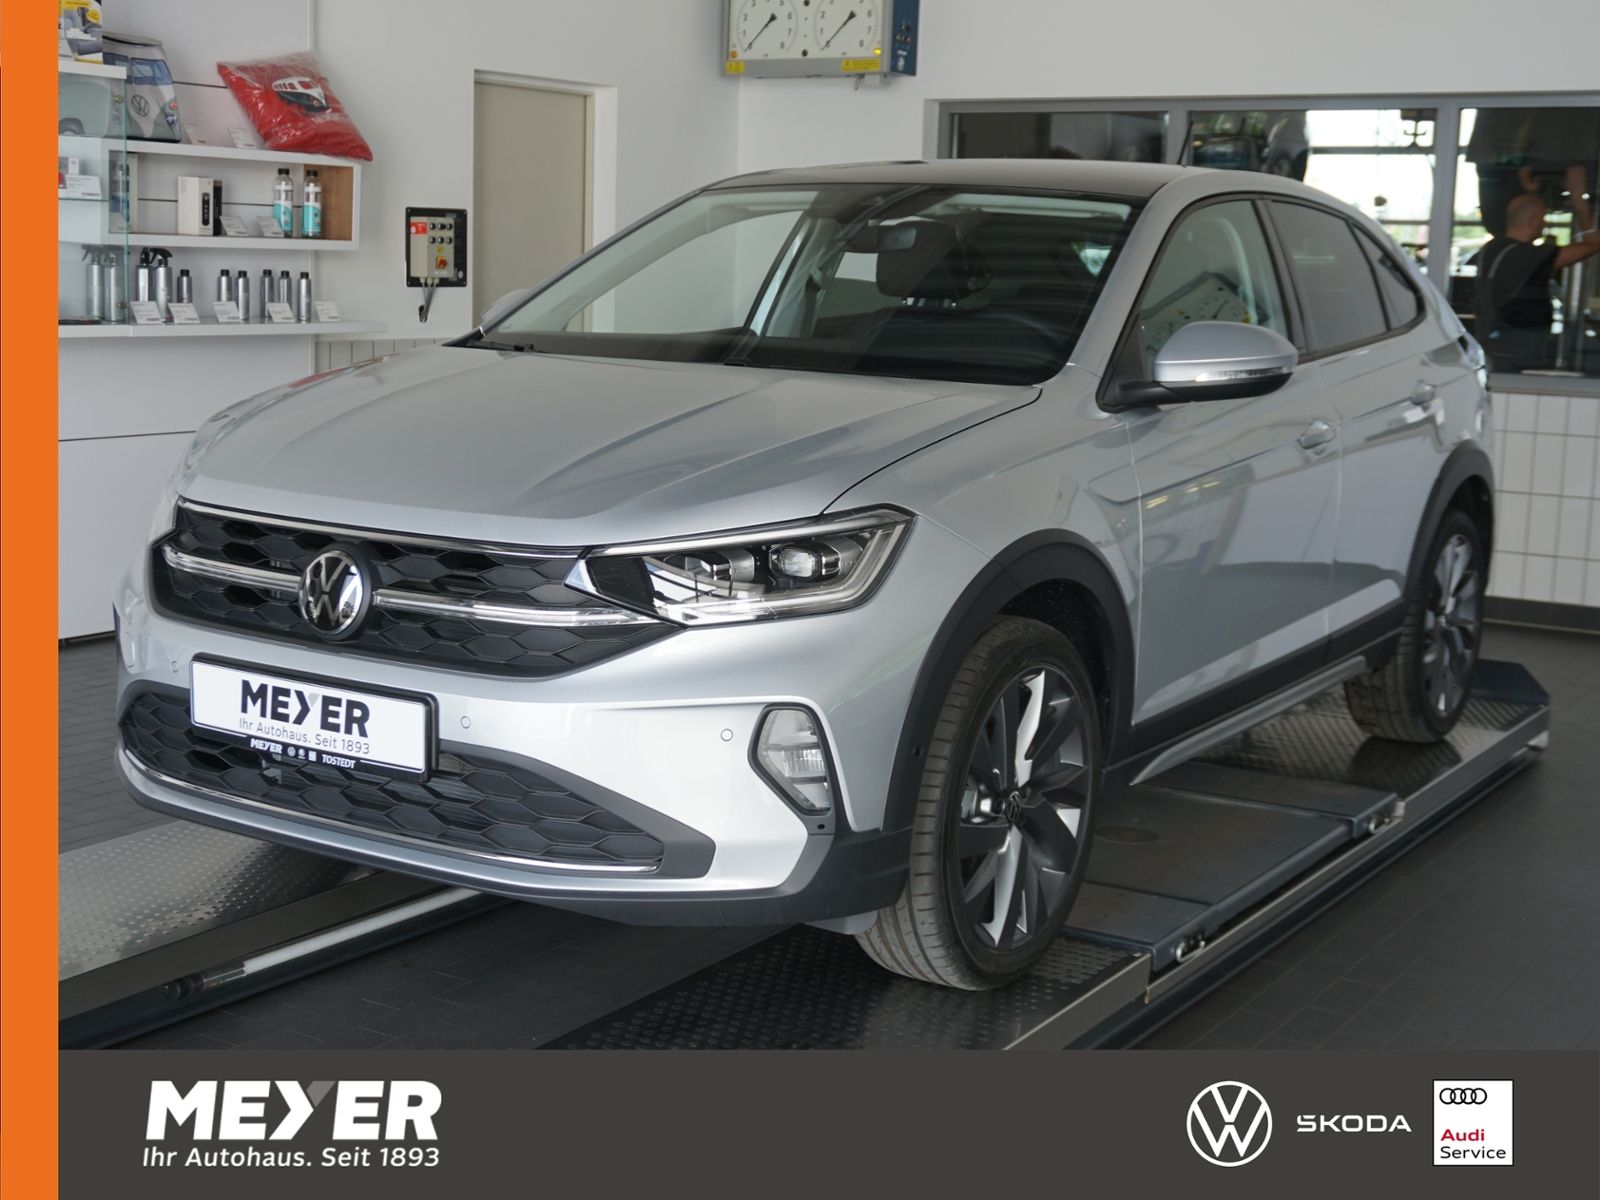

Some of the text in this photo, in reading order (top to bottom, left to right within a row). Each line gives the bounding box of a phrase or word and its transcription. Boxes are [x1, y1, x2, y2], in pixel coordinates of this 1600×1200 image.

[241, 679, 370, 738] MEYER
[239, 718, 370, 754] Ihr Autohaus. Seit 1893
[250, 738, 283, 754] MEYER
[321, 753, 357, 769] TOSTEDT
